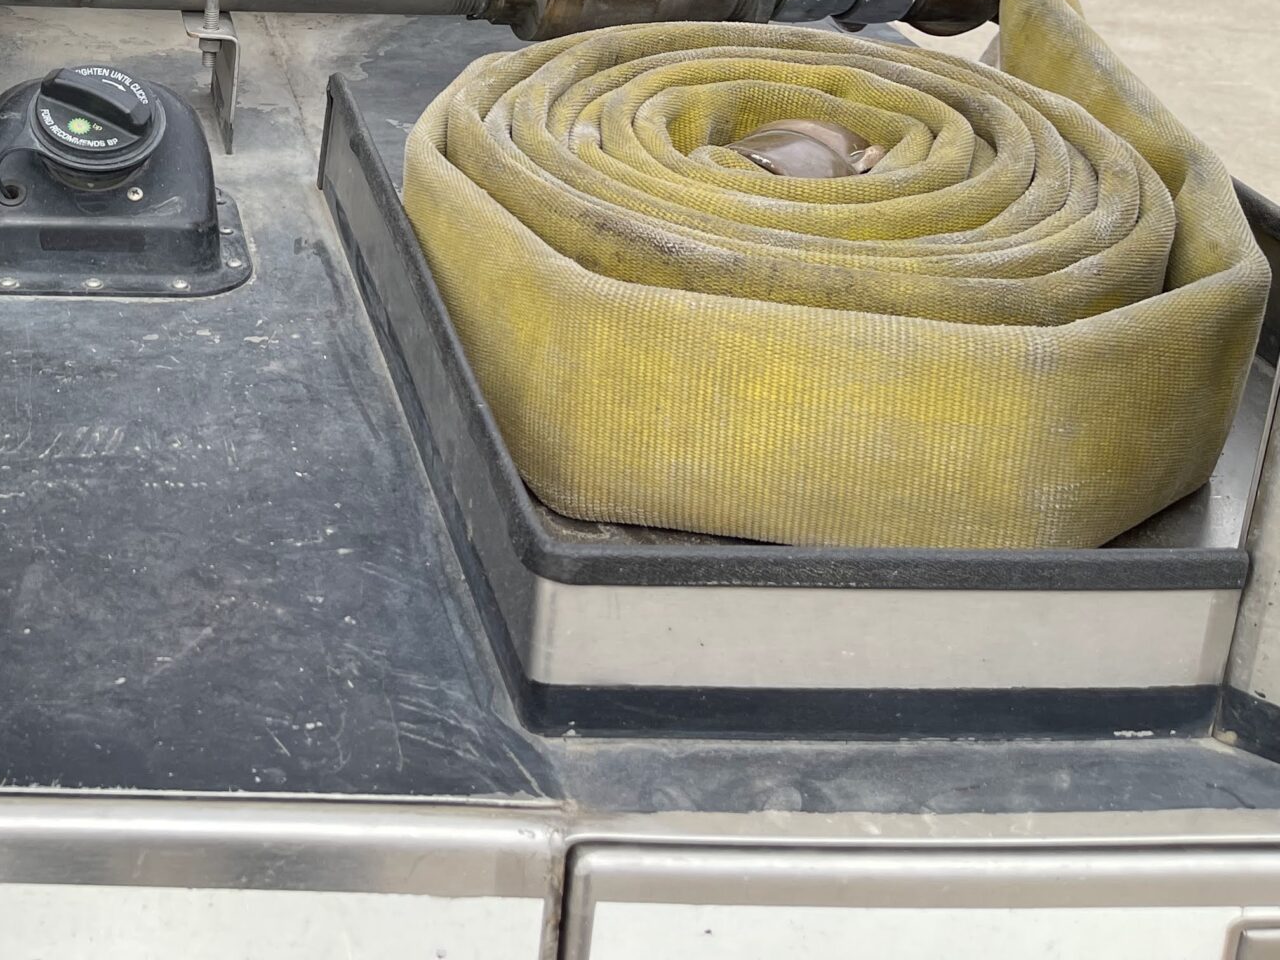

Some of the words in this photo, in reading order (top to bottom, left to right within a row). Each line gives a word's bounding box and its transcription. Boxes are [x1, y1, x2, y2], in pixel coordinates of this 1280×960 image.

[110, 70, 132, 86] UNTIL
[40, 108, 55, 126] FORD
[49, 124, 106, 147] RECOMMENDS
[106, 137, 118, 147] BP
